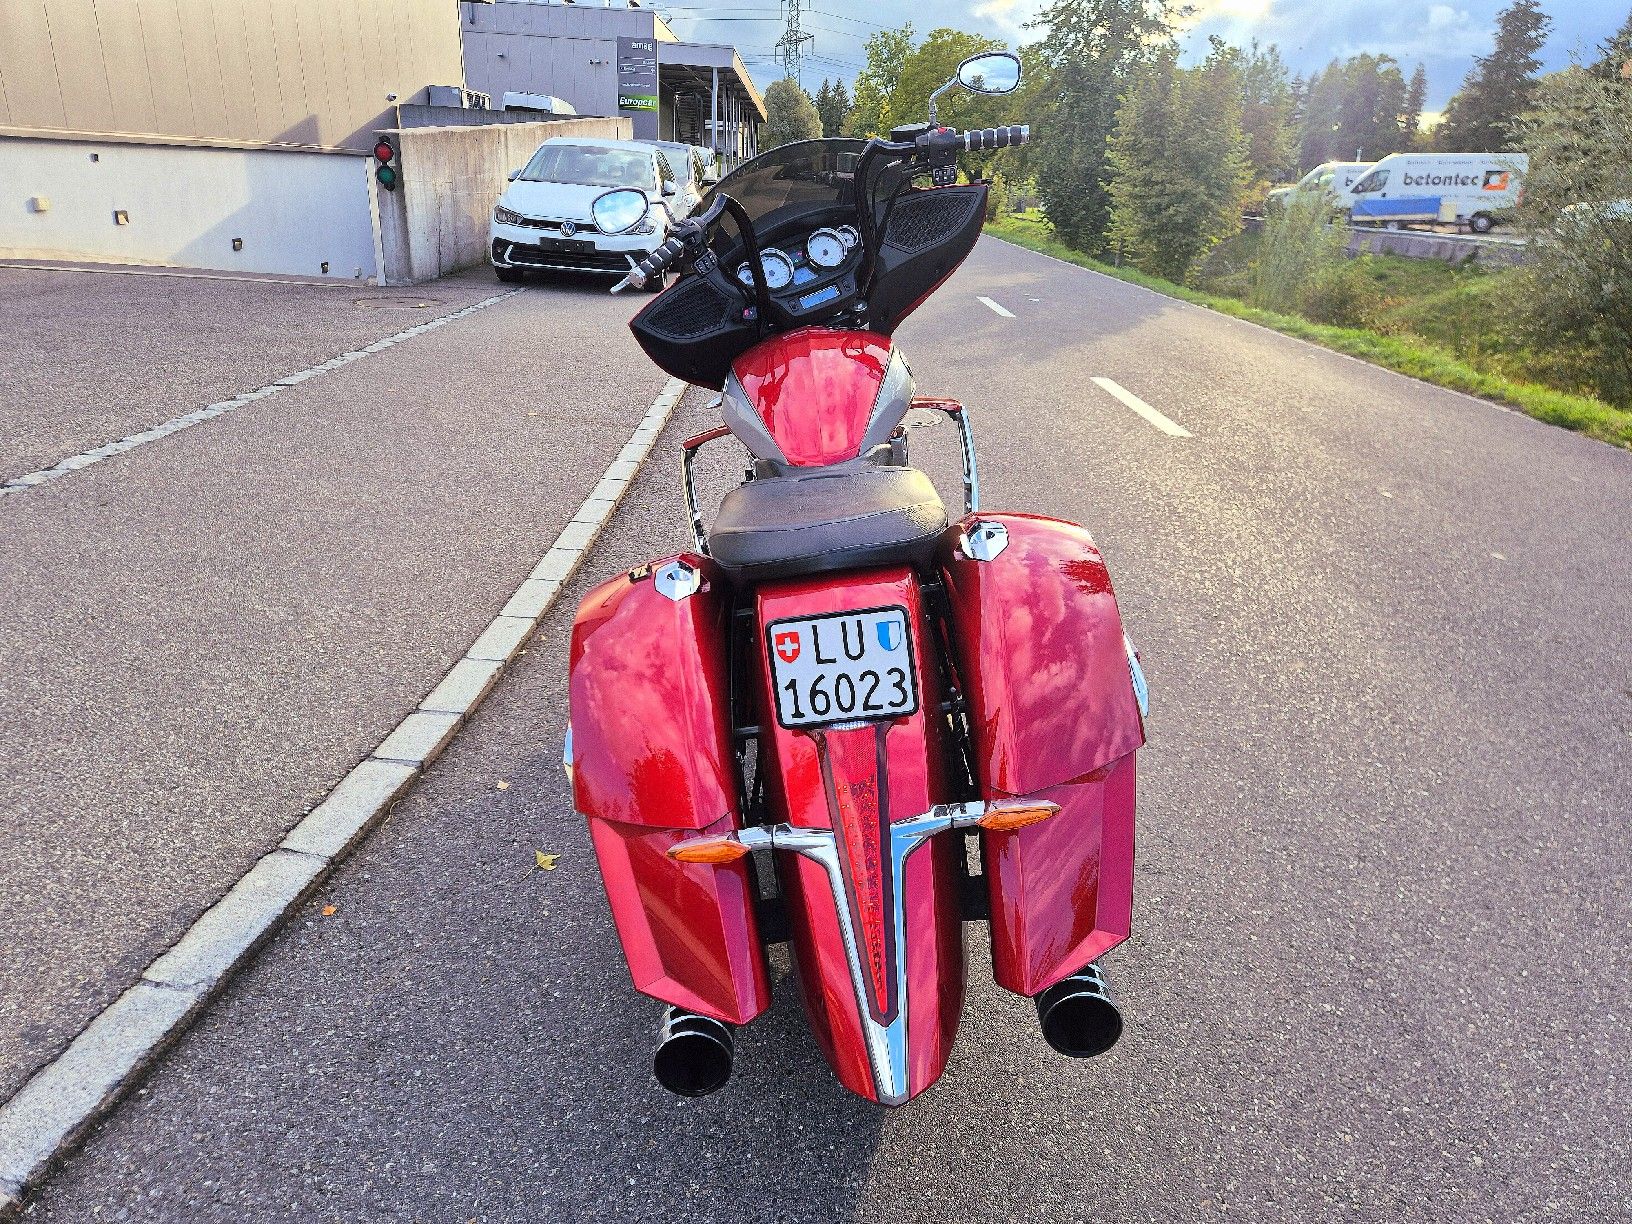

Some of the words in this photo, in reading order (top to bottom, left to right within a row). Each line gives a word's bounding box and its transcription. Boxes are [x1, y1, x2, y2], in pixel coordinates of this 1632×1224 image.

[619, 96, 657, 109] Europcar
[1403, 172, 1479, 187] betontec
[811, 619, 866, 665] LU
[784, 667, 909, 719] 16023
